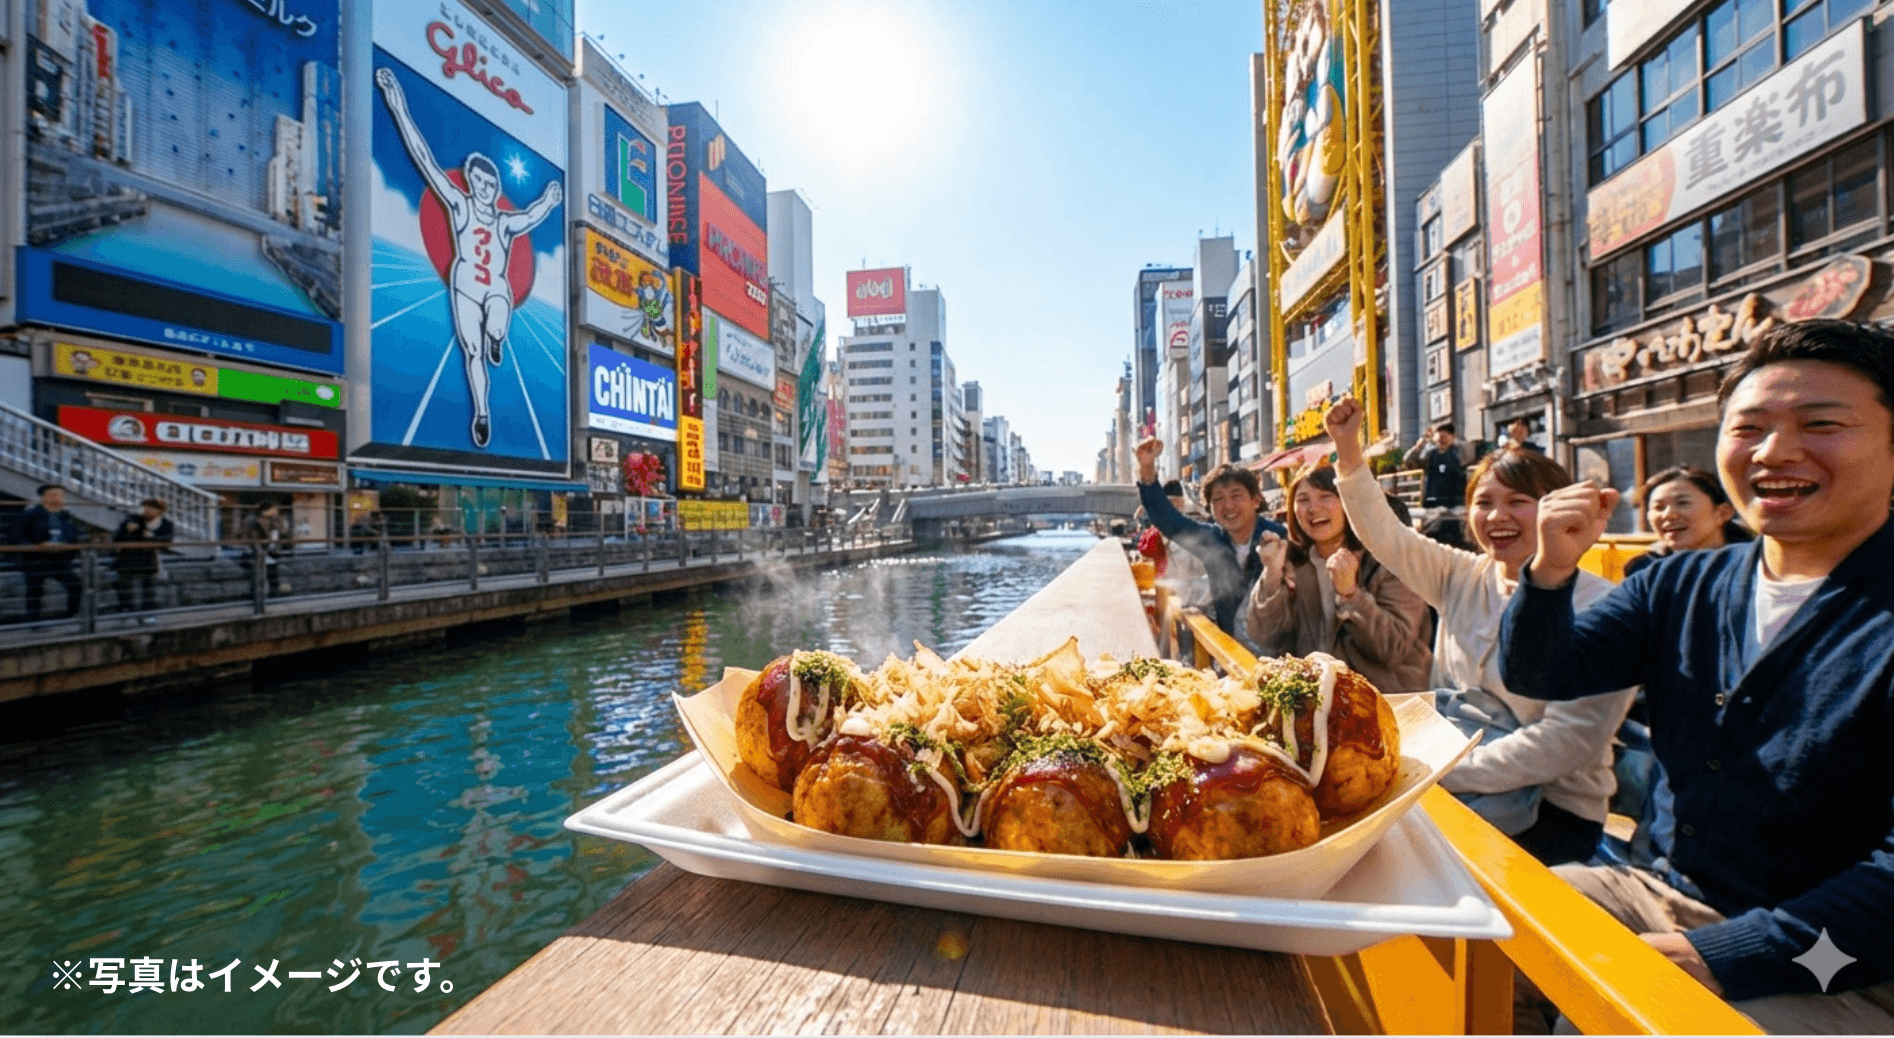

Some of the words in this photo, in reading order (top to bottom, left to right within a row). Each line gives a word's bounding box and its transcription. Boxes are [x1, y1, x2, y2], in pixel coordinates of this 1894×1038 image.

[425, 21, 535, 116] Glico
[1684, 50, 1847, 191] 重楽布
[594, 362, 674, 421] CHINTAI
